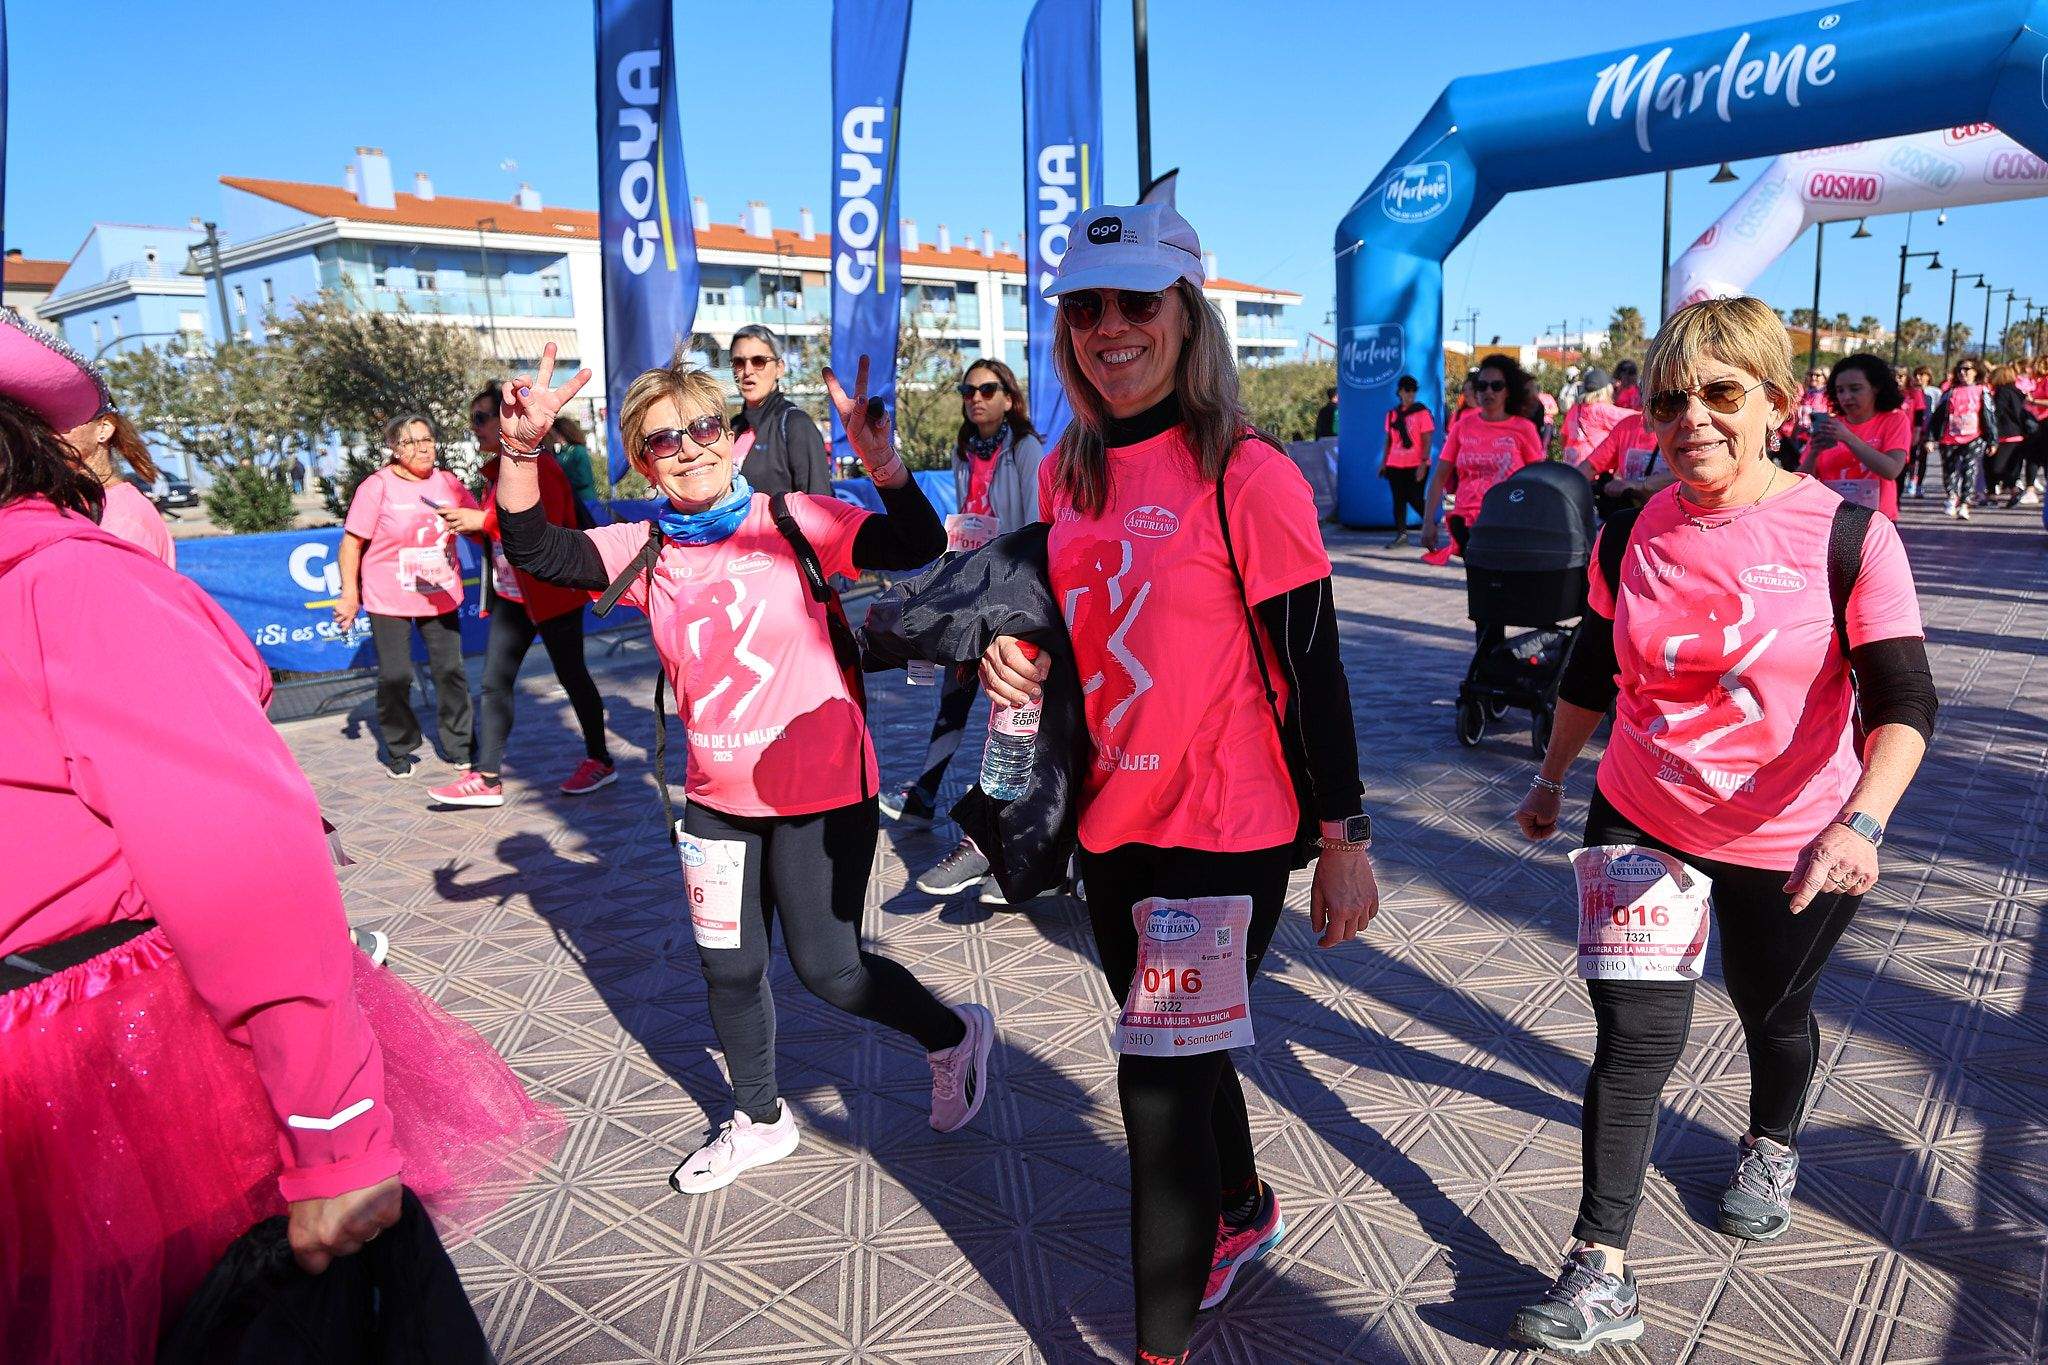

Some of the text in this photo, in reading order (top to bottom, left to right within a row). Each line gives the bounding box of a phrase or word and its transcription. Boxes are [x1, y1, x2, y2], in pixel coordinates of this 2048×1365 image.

[1586, 32, 1837, 154] Marlene
[616, 48, 662, 276] GOYA
[1386, 176, 1446, 209] Marlene
[1810, 174, 1877, 201] COSMO
[835, 105, 885, 296] GOYA
[1091, 224, 1119, 237] ago
[1342, 340, 1399, 372] Marlene
[1127, 515, 1174, 532] ASTURIANA
[292, 626, 315, 642] es
[1013, 710, 1040, 719] ZERO
[711, 734, 725, 749] DE
[727, 733, 741, 749] LA
[1119, 753, 1160, 771] UJER
[1701, 768, 1757, 793] MUJER
[1609, 863, 1663, 876] ASTURIANA
[1612, 905, 1670, 927] 016
[1624, 932, 1652, 943] 7321
[1613, 946, 1623, 954] DE
[1624, 946, 1634, 954] LA
[1586, 960, 1626, 971] OYSHO
[1143, 968, 1203, 994] 016
[1153, 1000, 1182, 1013] 7322
[1142, 1016, 1152, 1024] DE
[1153, 1016, 1162, 1025] LA
[1164, 1017, 1190, 1026] MUJER
[1197, 1011, 1230, 1024] VALENCIA
[1187, 1030, 1233, 1047] Santander
